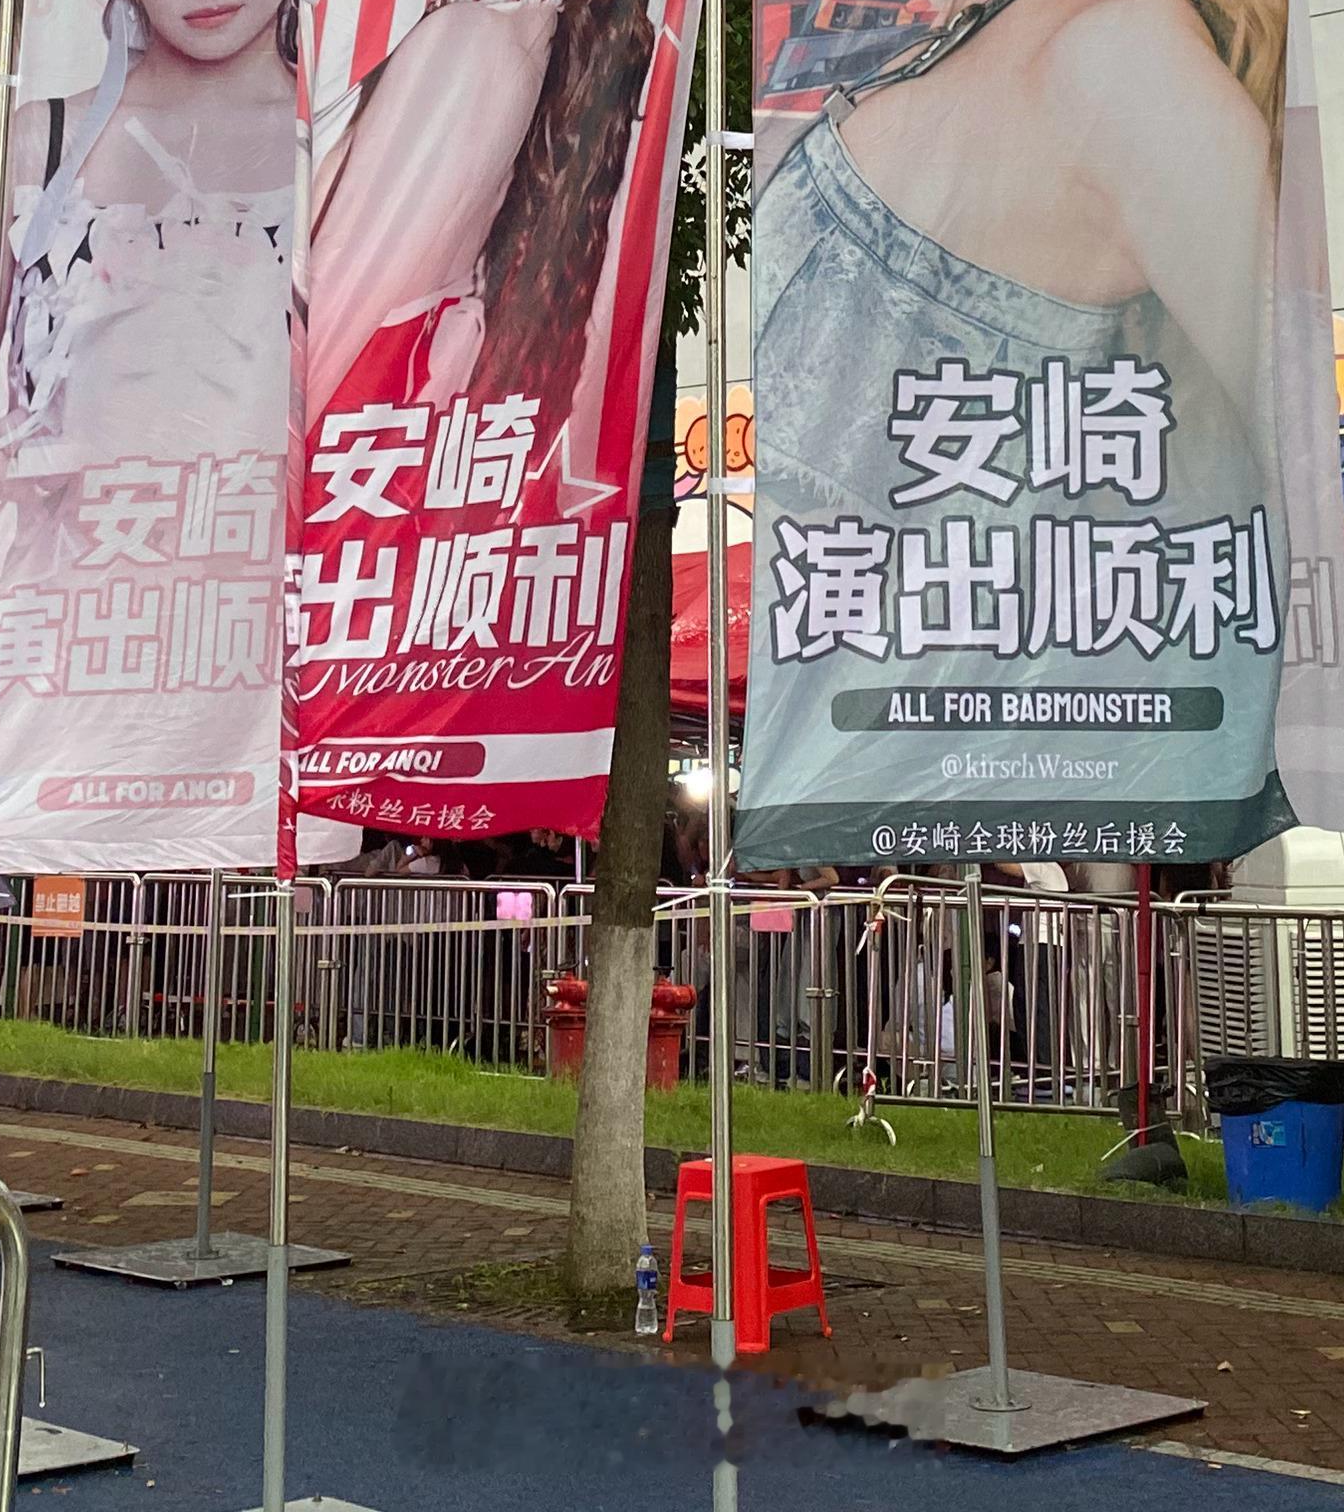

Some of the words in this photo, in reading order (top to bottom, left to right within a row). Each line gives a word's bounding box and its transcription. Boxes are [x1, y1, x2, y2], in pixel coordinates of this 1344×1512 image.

[305, 393, 541, 524] 安崎
[891, 356, 1172, 506] 安崎
[74, 450, 280, 568] 安崎
[285, 522, 628, 667] 出顺利
[772, 506, 1279, 664] 演出顺利
[512, 632, 616, 688] An
[888, 692, 934, 724] ALL
[944, 692, 992, 724] FOR
[1001, 691, 1172, 724] BABMONSTER
[336, 750, 380, 774] FOR
[383, 748, 443, 773] ANQI
[941, 752, 1119, 781] @kirschWasser
[67, 781, 111, 804] ALL
[115, 780, 165, 803] FOR
[170, 778, 237, 801] ANQI
[872, 820, 1188, 858] @安崎全球粉丝后援会
